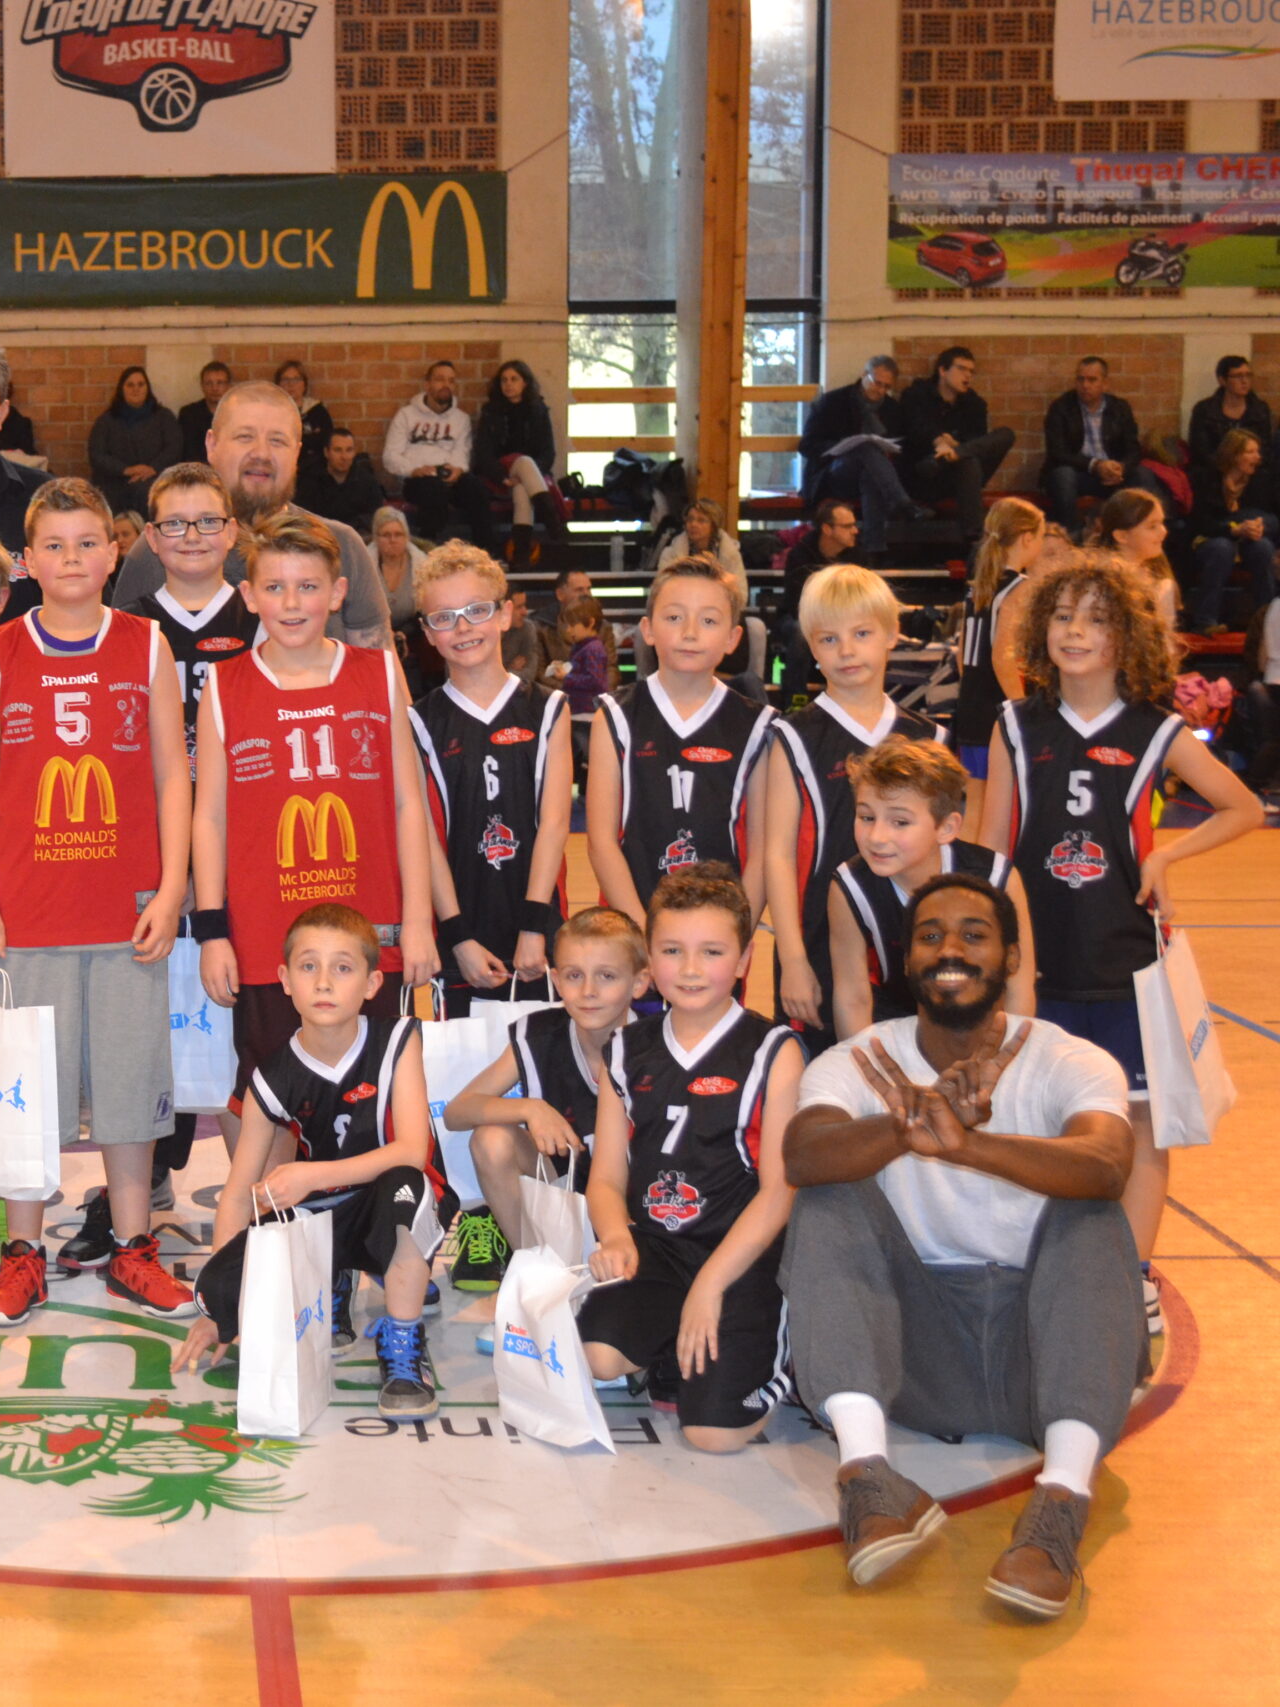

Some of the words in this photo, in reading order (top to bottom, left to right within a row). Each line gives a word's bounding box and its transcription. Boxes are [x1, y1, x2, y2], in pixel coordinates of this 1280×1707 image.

[103, 37, 235, 65] BASKET-BALL
[954, 164, 975, 181] de
[980, 164, 1060, 181] Conduite
[987, 211, 1004, 224] de
[1006, 211, 1047, 227] points
[1112, 212, 1128, 224] de
[1131, 213, 1191, 227] paiement
[13, 228, 334, 273] HAZEBROUCK
[41, 672, 98, 687] SPALDING
[54, 692, 91, 746] 5
[277, 705, 335, 721] SPALDING
[230, 737, 272, 756] VIVASPORT
[284, 724, 340, 781] 11
[483, 755, 500, 801] 6
[1066, 769, 1093, 816] 5
[35, 833, 51, 846] Mc
[54, 829, 117, 846] DONALD'S
[35, 846, 117, 862] HAZEBROUCK
[280, 873, 297, 886] Mc
[299, 867, 356, 885] DONALD'S
[281, 883, 357, 902] HAZEBROUCK
[660, 1105, 690, 1154] 7
